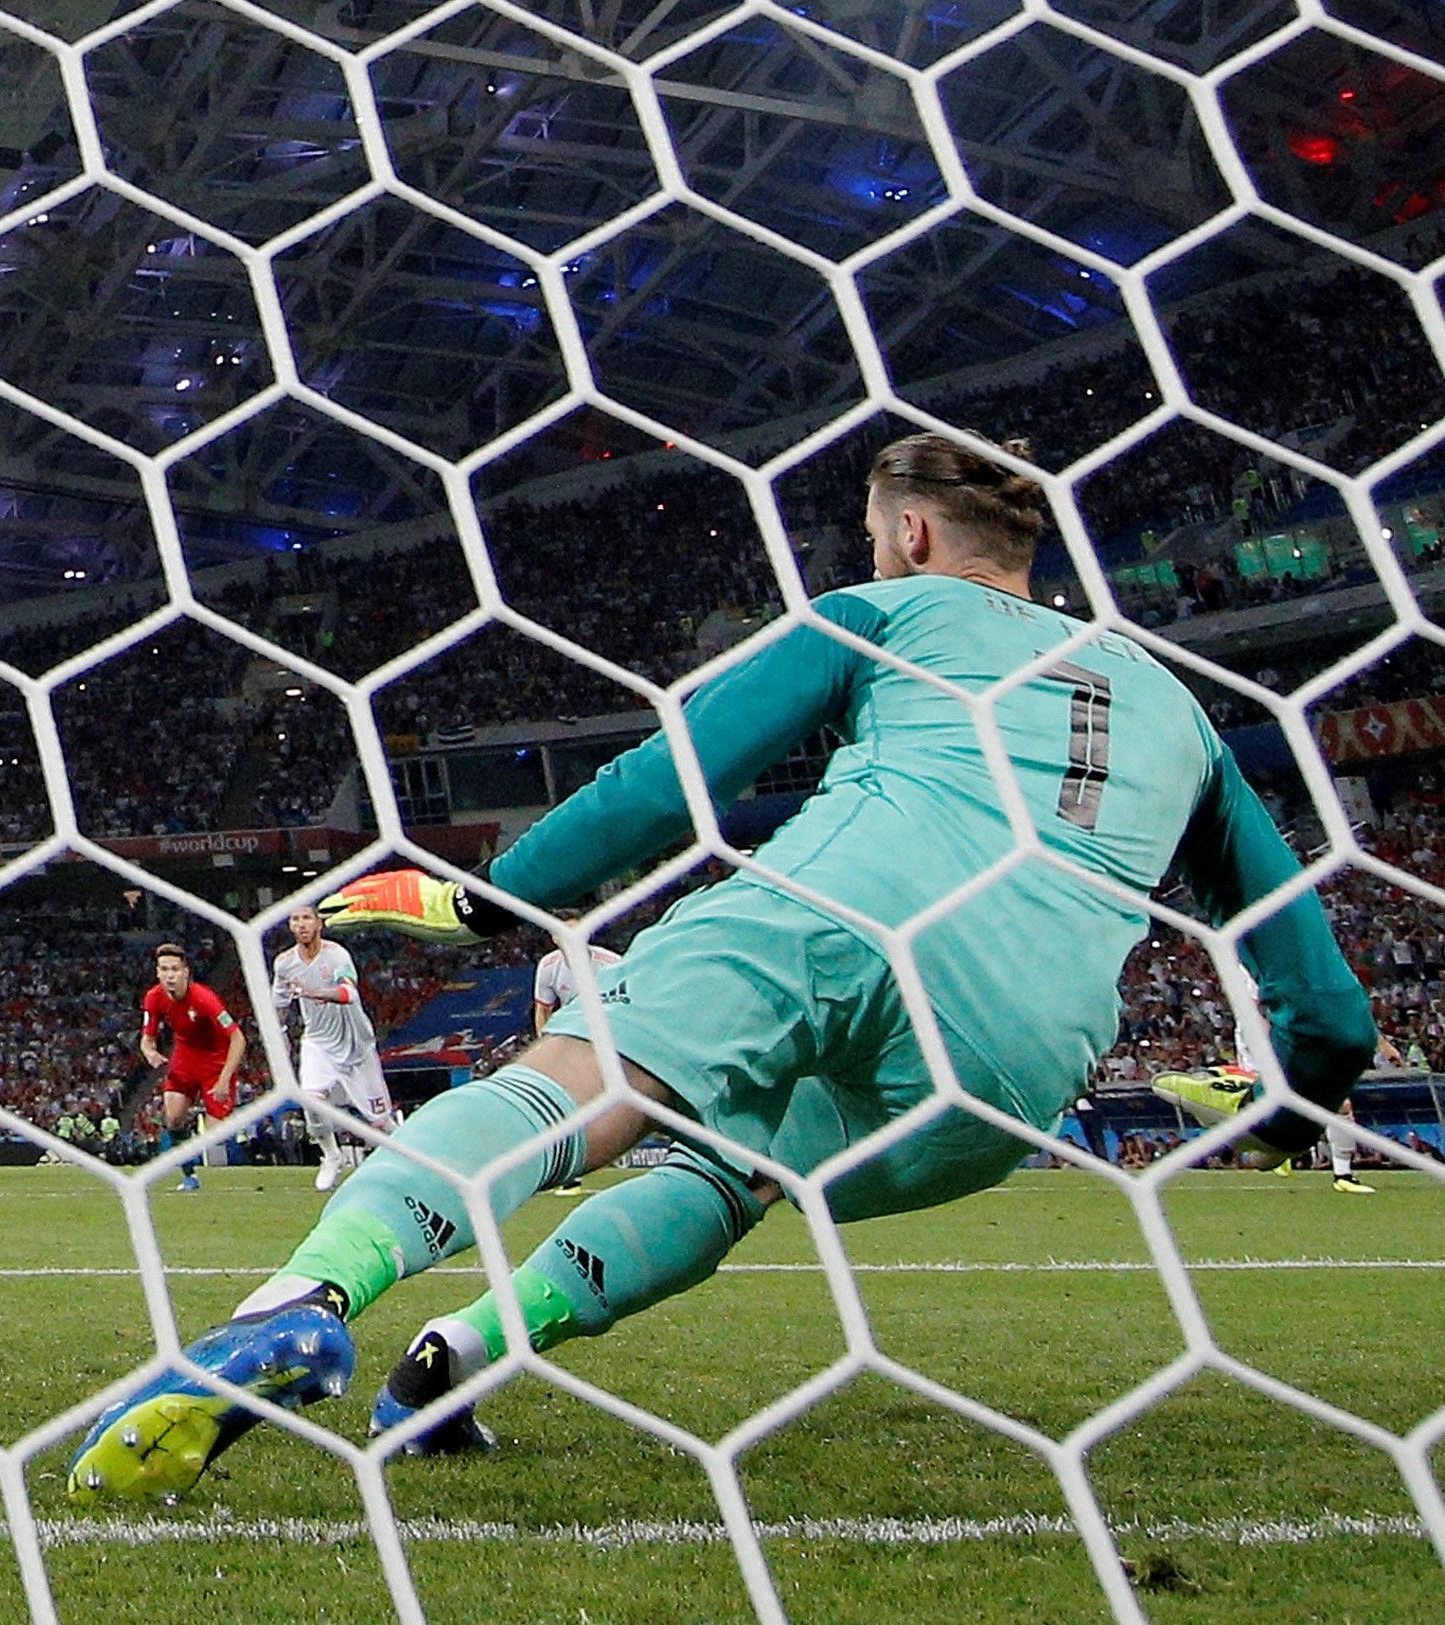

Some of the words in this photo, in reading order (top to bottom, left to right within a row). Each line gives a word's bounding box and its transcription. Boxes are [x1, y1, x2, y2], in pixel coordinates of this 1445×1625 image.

[1034, 650, 1112, 834] 1
[159, 833, 259, 854] #worldcup
[367, 1098, 387, 1115] 15
